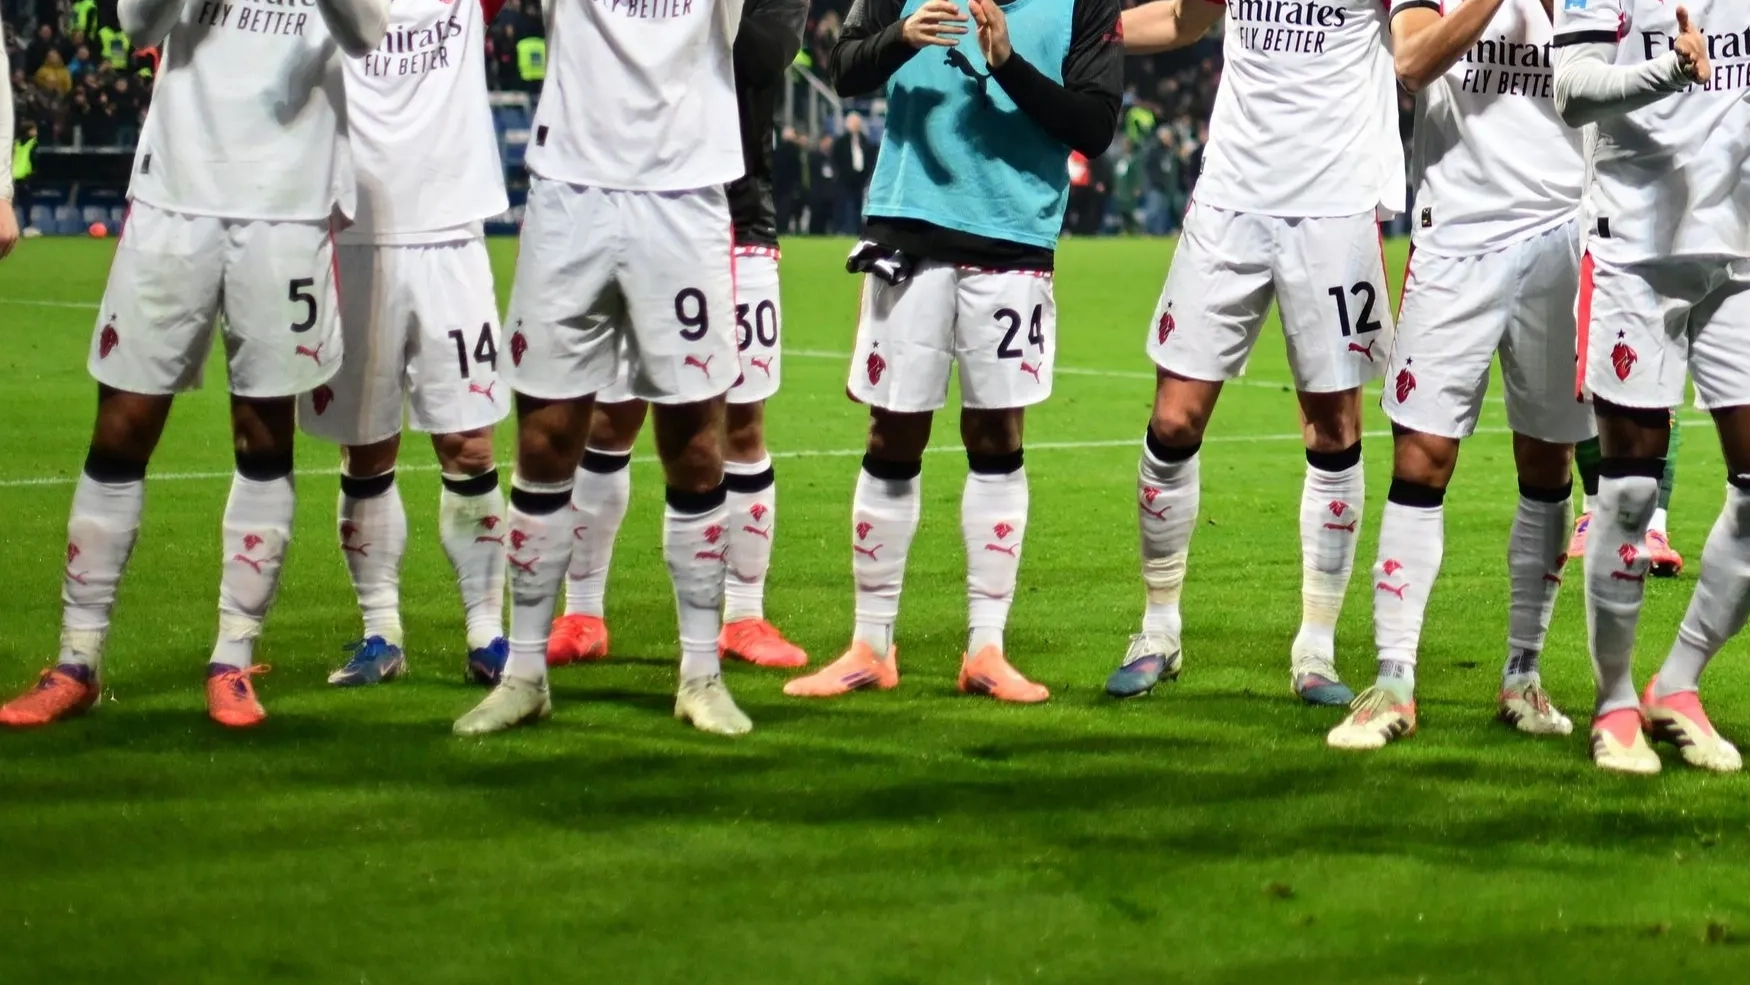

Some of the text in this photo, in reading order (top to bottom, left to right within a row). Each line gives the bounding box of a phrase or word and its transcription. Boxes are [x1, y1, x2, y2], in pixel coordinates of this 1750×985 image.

[199, 1, 307, 35] FLY BETTER
[1240, 26, 1325, 53] FLY BETTER
[365, 54, 391, 76] FLY
[1462, 69, 1553, 98] FLY BETTE
[289, 277, 317, 333] 5
[674, 287, 709, 341] 9
[993, 304, 1045, 359] 24
[1328, 281, 1382, 337] 12
[448, 322, 497, 378] 14
